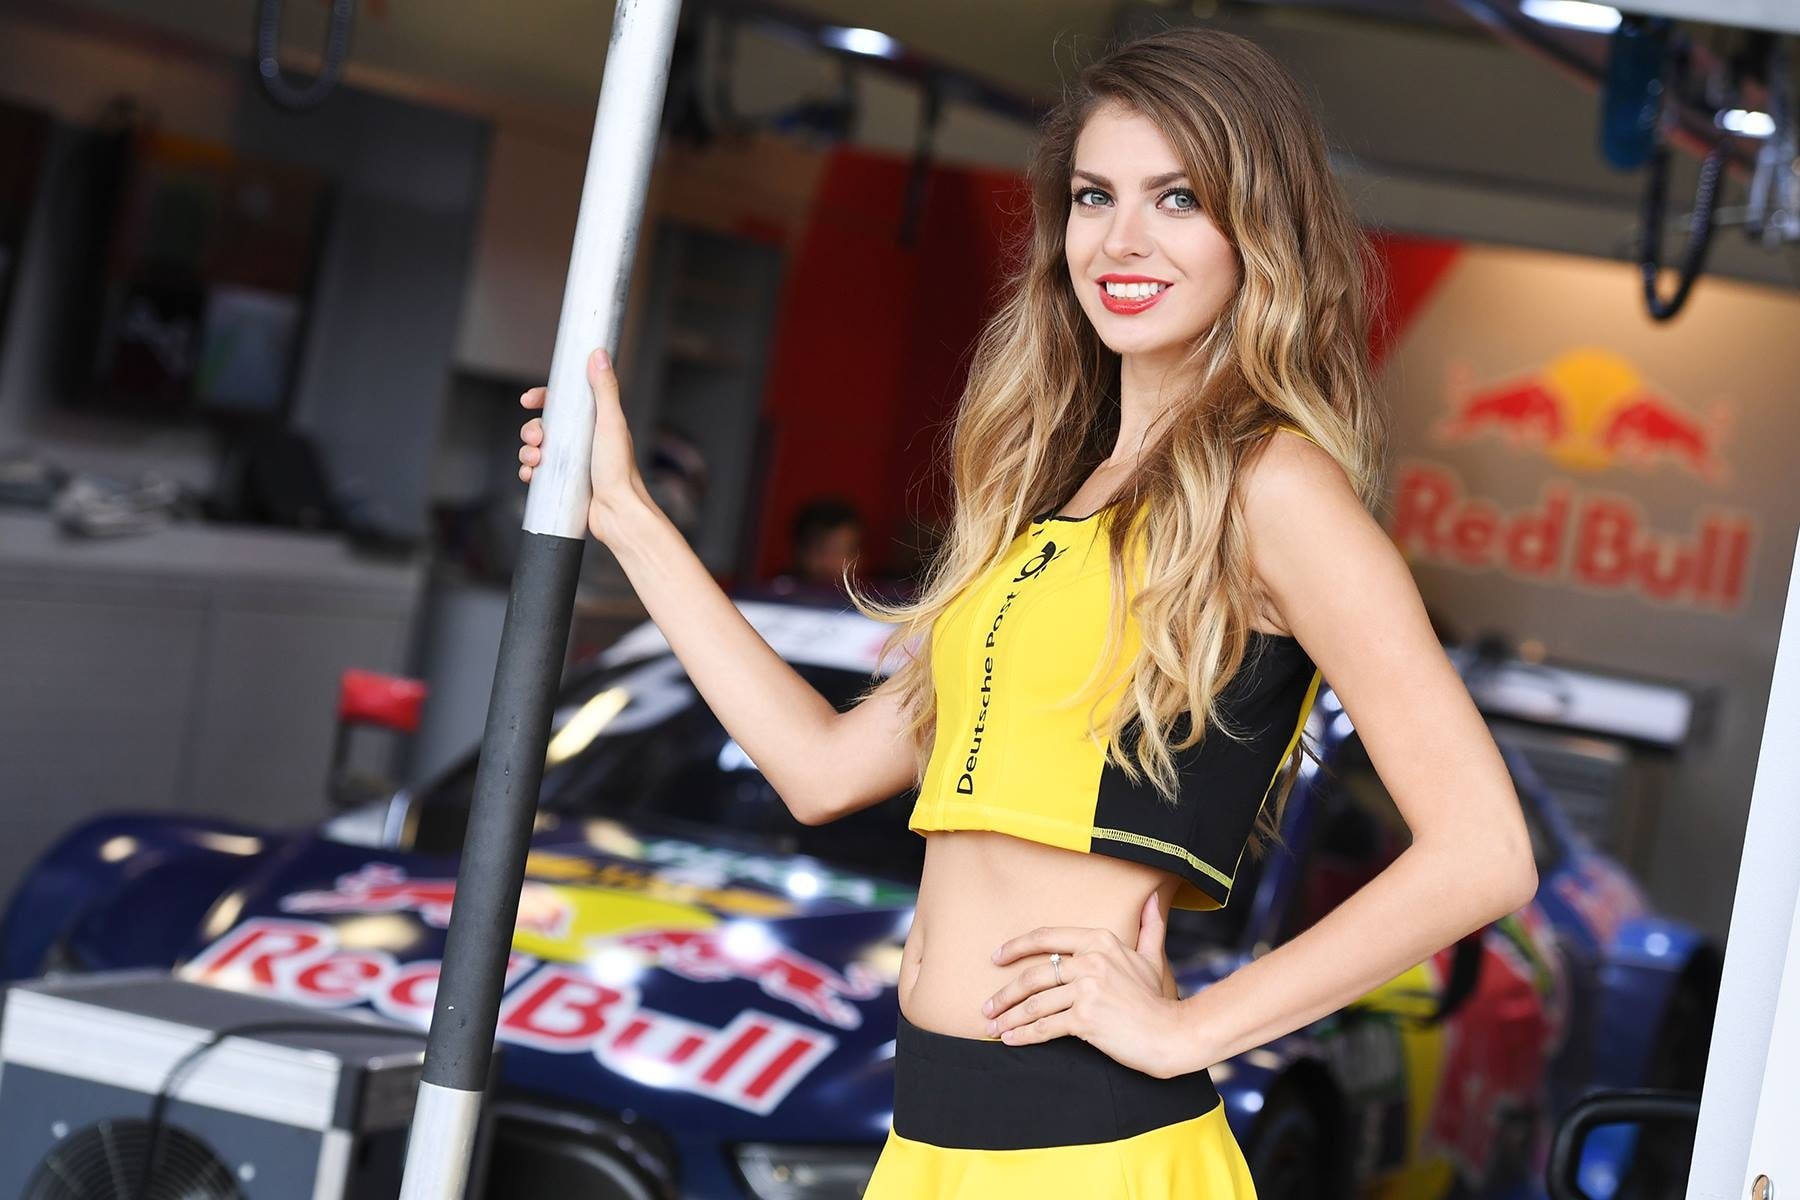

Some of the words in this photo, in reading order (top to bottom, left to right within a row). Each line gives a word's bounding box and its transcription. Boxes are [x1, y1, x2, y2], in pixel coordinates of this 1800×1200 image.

[1392, 466, 1571, 577] Red
[1573, 498, 1754, 613] Bull
[956, 656, 993, 795] Deutsche
[986, 592, 1020, 648] Post
[501, 971, 832, 1108] Bull
